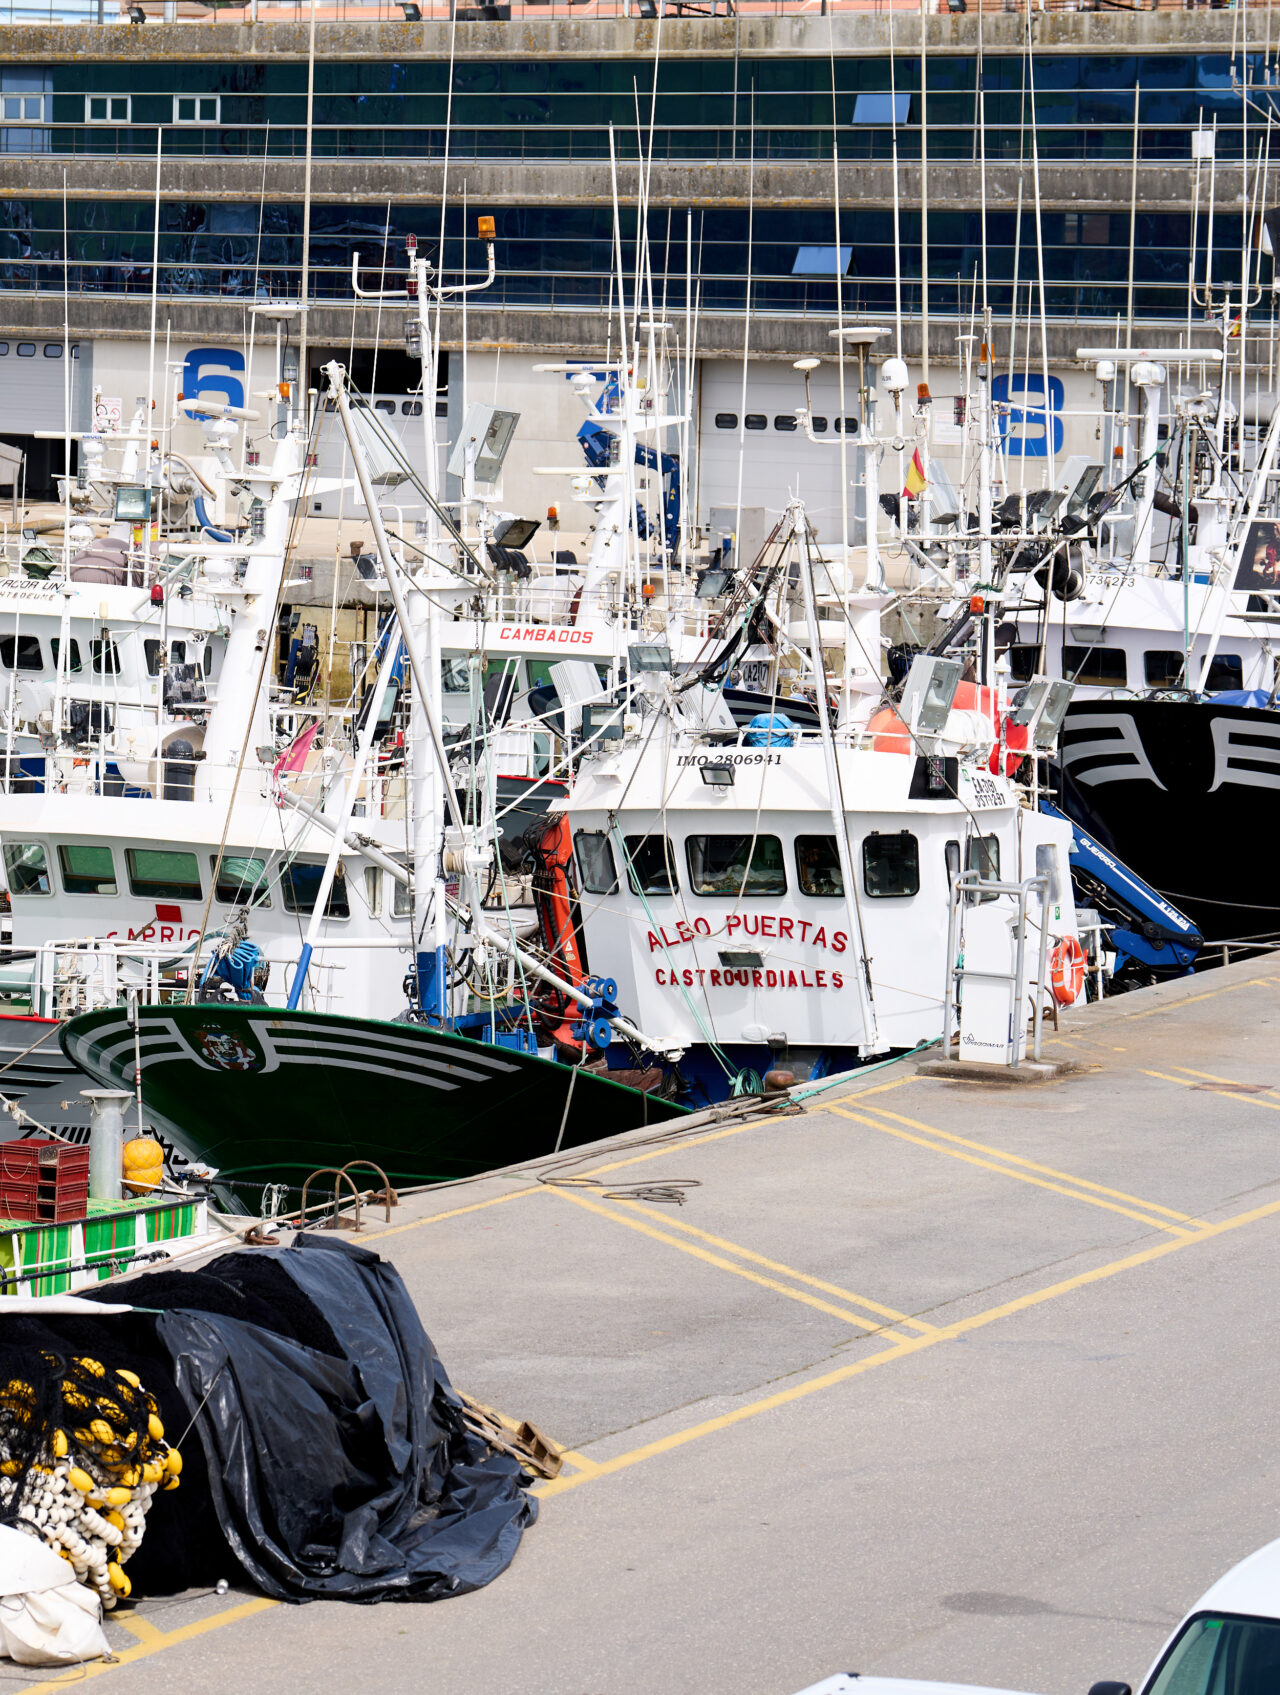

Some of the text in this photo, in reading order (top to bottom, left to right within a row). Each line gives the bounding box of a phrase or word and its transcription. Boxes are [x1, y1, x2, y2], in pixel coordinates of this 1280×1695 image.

[183, 348, 245, 421] 6
[991, 373, 1064, 456] 8
[500, 627, 594, 645] CAMBADOS
[1080, 838, 1116, 869] GUERRA
[726, 914, 848, 953] PUERTAS
